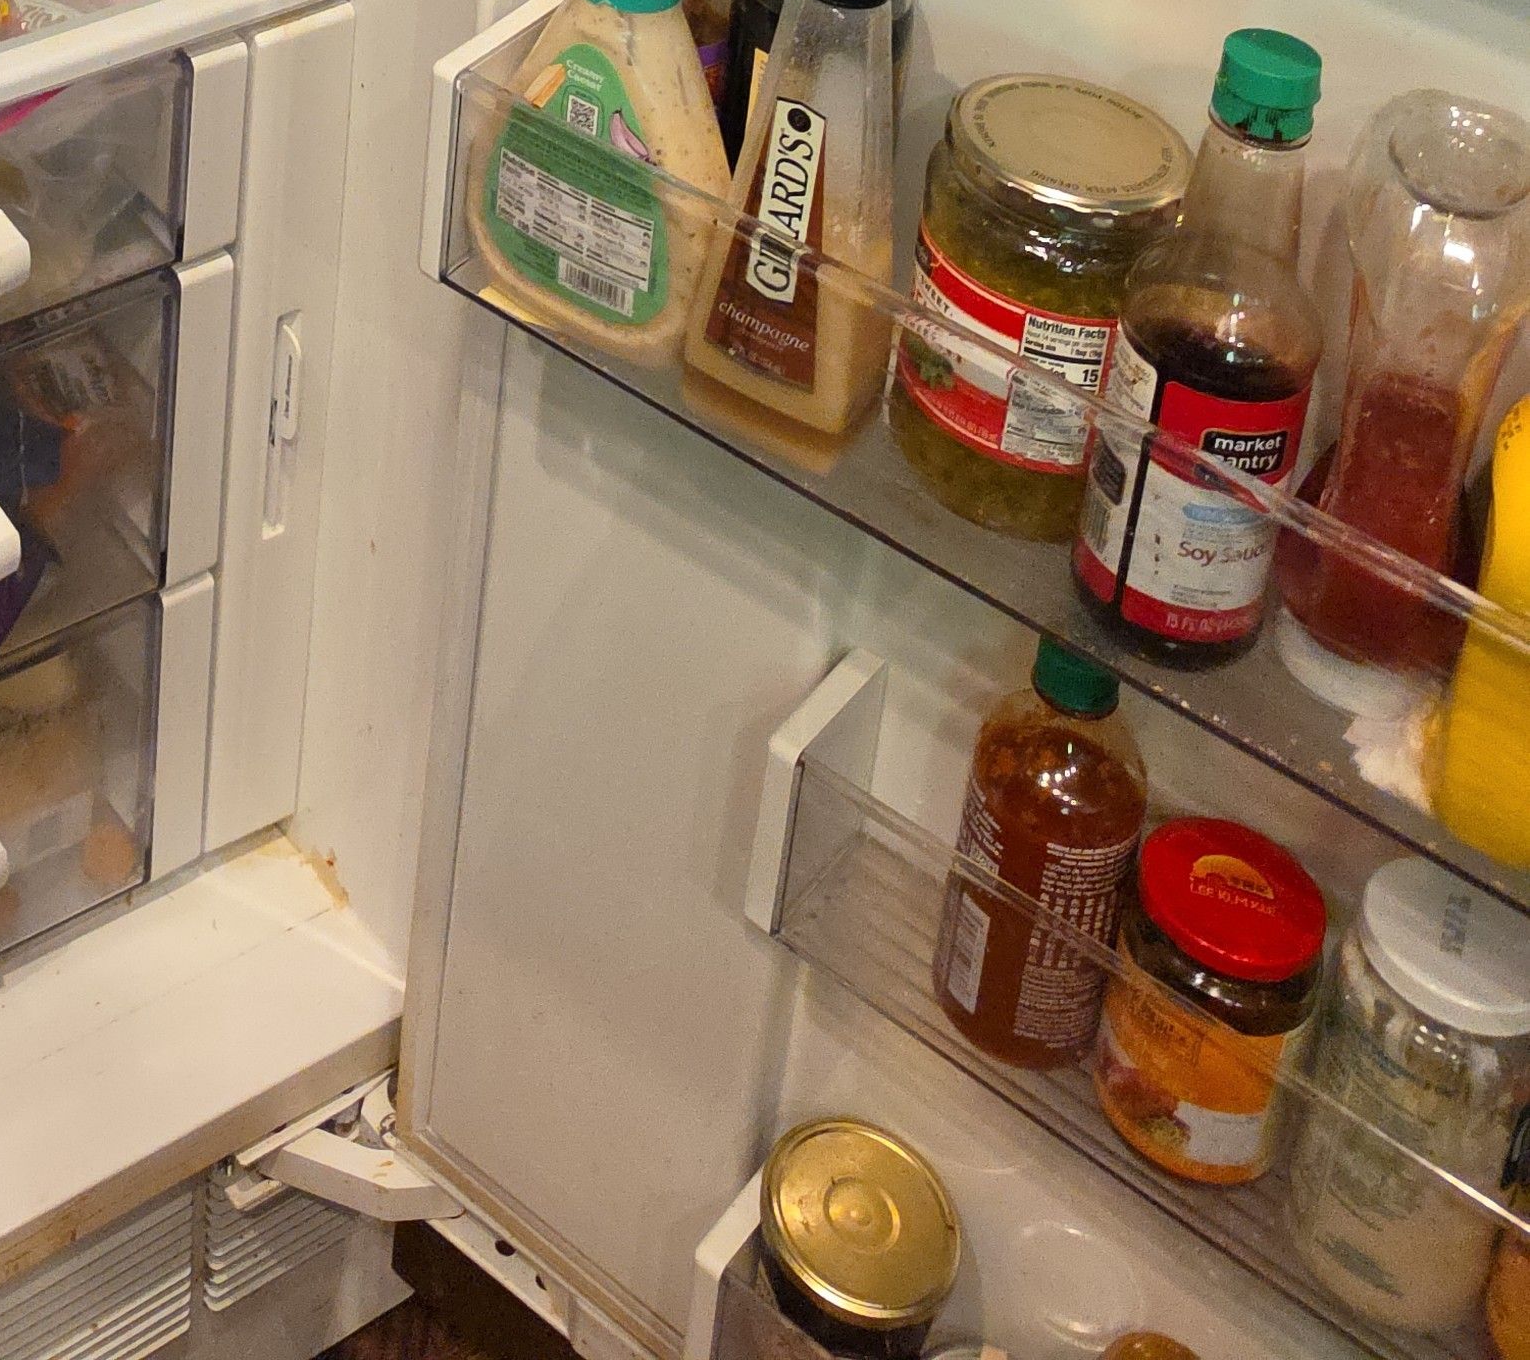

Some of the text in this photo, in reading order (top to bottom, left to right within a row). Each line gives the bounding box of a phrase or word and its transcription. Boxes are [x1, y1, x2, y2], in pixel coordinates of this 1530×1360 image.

[717, 300, 810, 353] champagne
[1027, 316, 1107, 340] Nutrition Facts
[1082, 368, 1100, 384] 15
[1214, 435, 1283, 453] market
[1177, 540, 1218, 567] Soy
